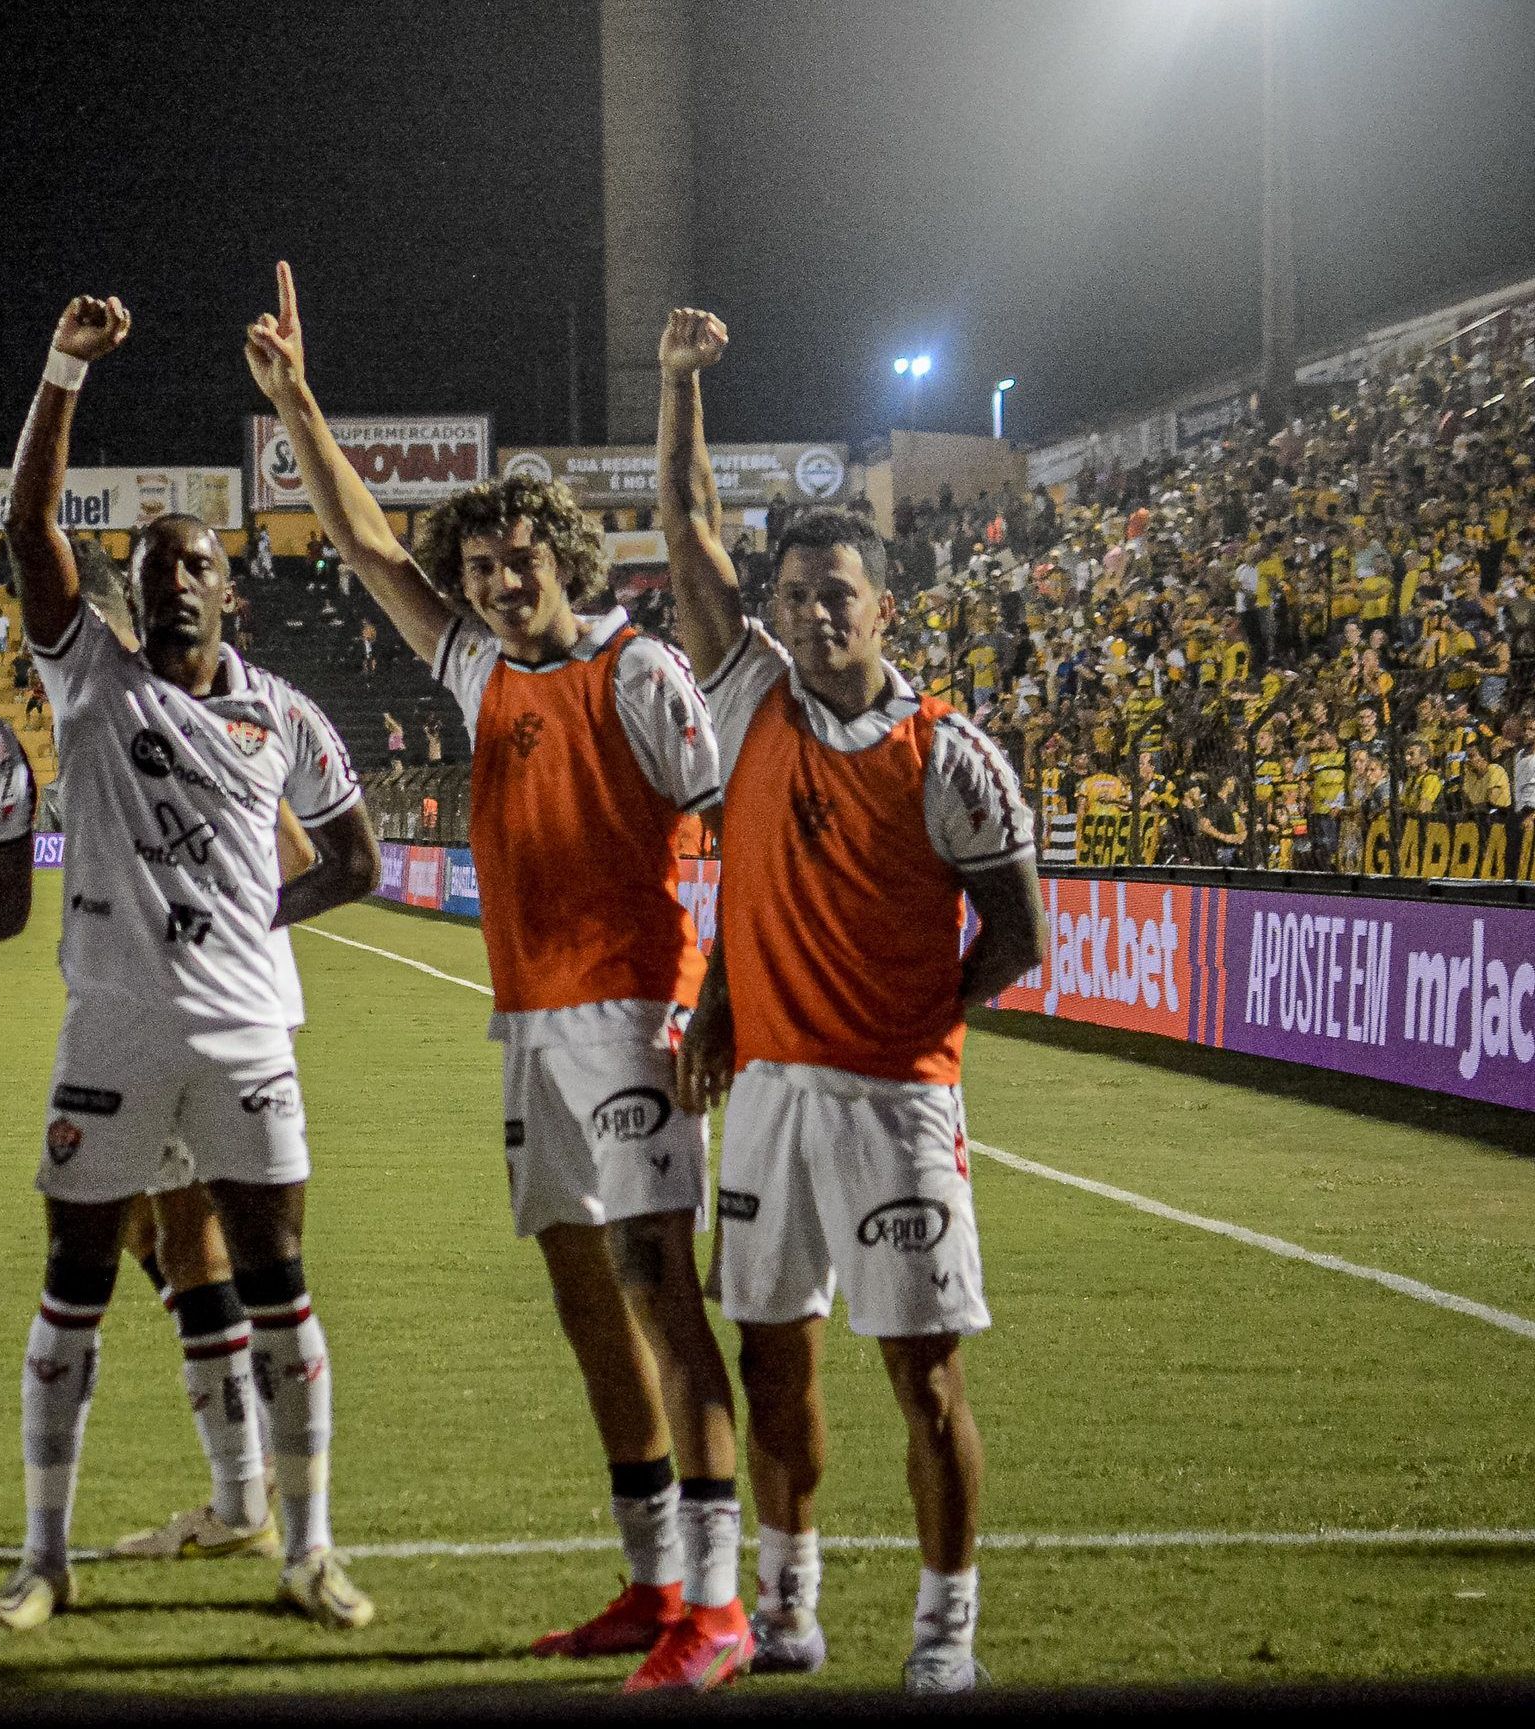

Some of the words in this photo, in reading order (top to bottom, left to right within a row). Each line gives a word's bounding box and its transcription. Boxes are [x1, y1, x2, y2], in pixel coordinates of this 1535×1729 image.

[1017, 880, 1179, 1016] Jack.bet
[1245, 911, 1346, 1038] APOSTE
[1346, 919, 1394, 1046] EM
